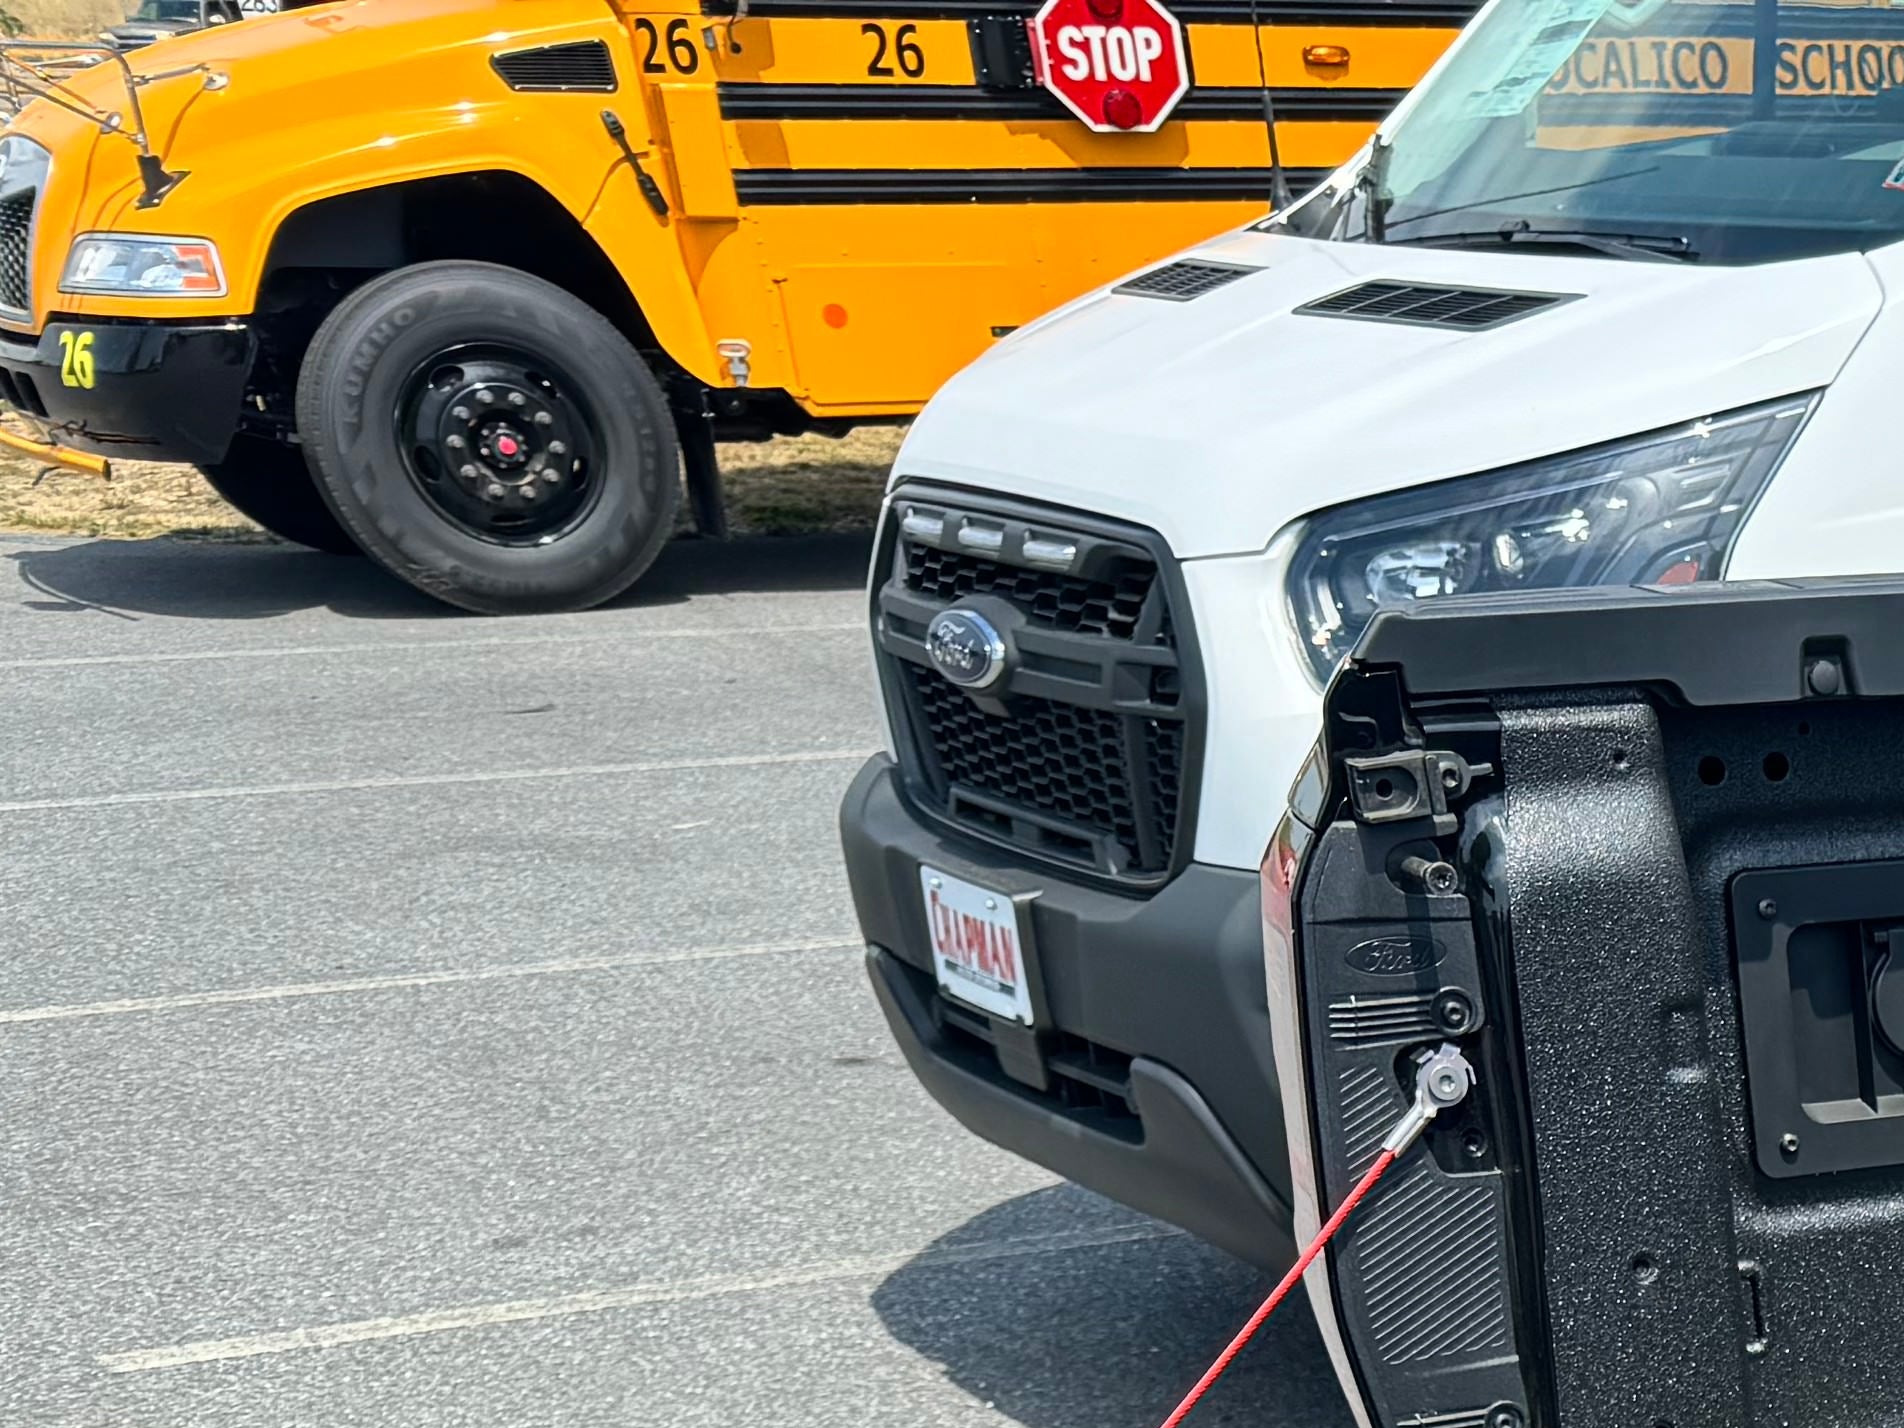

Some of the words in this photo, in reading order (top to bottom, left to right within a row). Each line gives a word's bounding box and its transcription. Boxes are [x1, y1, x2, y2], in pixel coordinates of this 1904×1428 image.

[635, 18, 699, 75] 26
[861, 23, 925, 77] 26
[1057, 25, 1163, 82] STOP
[60, 331, 94, 389] 26
[343, 307, 416, 425] KUMHO
[931, 619, 976, 670] Ford
[929, 889, 1018, 984] CHAPMAN
[1363, 940, 1430, 972] Ford
